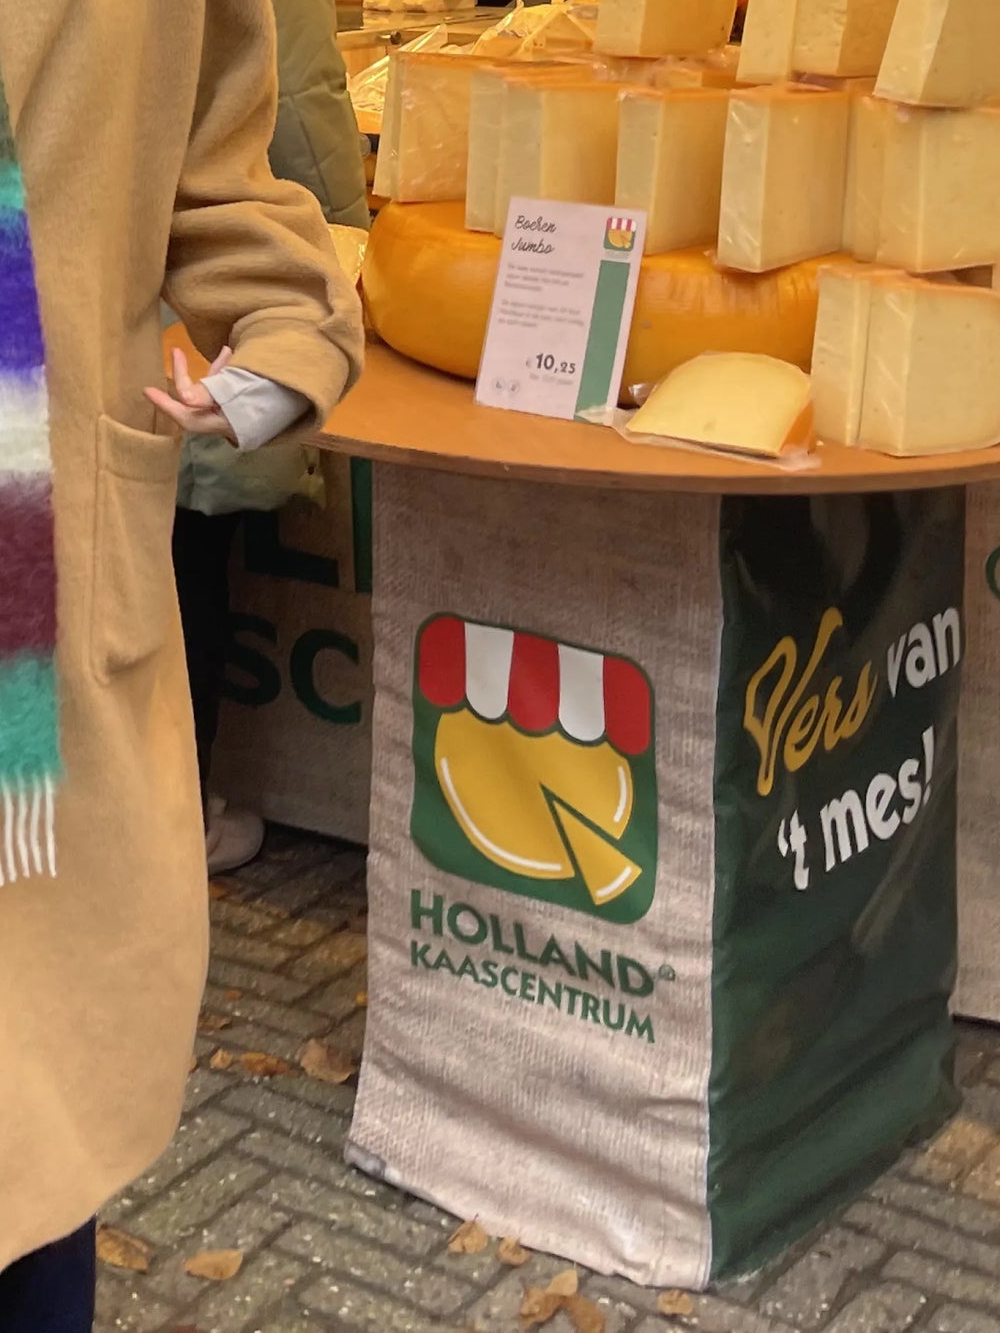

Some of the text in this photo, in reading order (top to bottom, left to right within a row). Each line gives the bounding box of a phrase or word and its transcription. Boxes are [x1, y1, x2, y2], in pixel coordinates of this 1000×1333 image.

[511, 237, 555, 254] Jumbo
[535, 353, 576, 374] 10,25
[744, 606, 960, 797] Vers van
[819, 725, 935, 873] mes!
[410, 888, 655, 998] HOLLAND
[410, 940, 656, 1044] KAASCENTRUM
